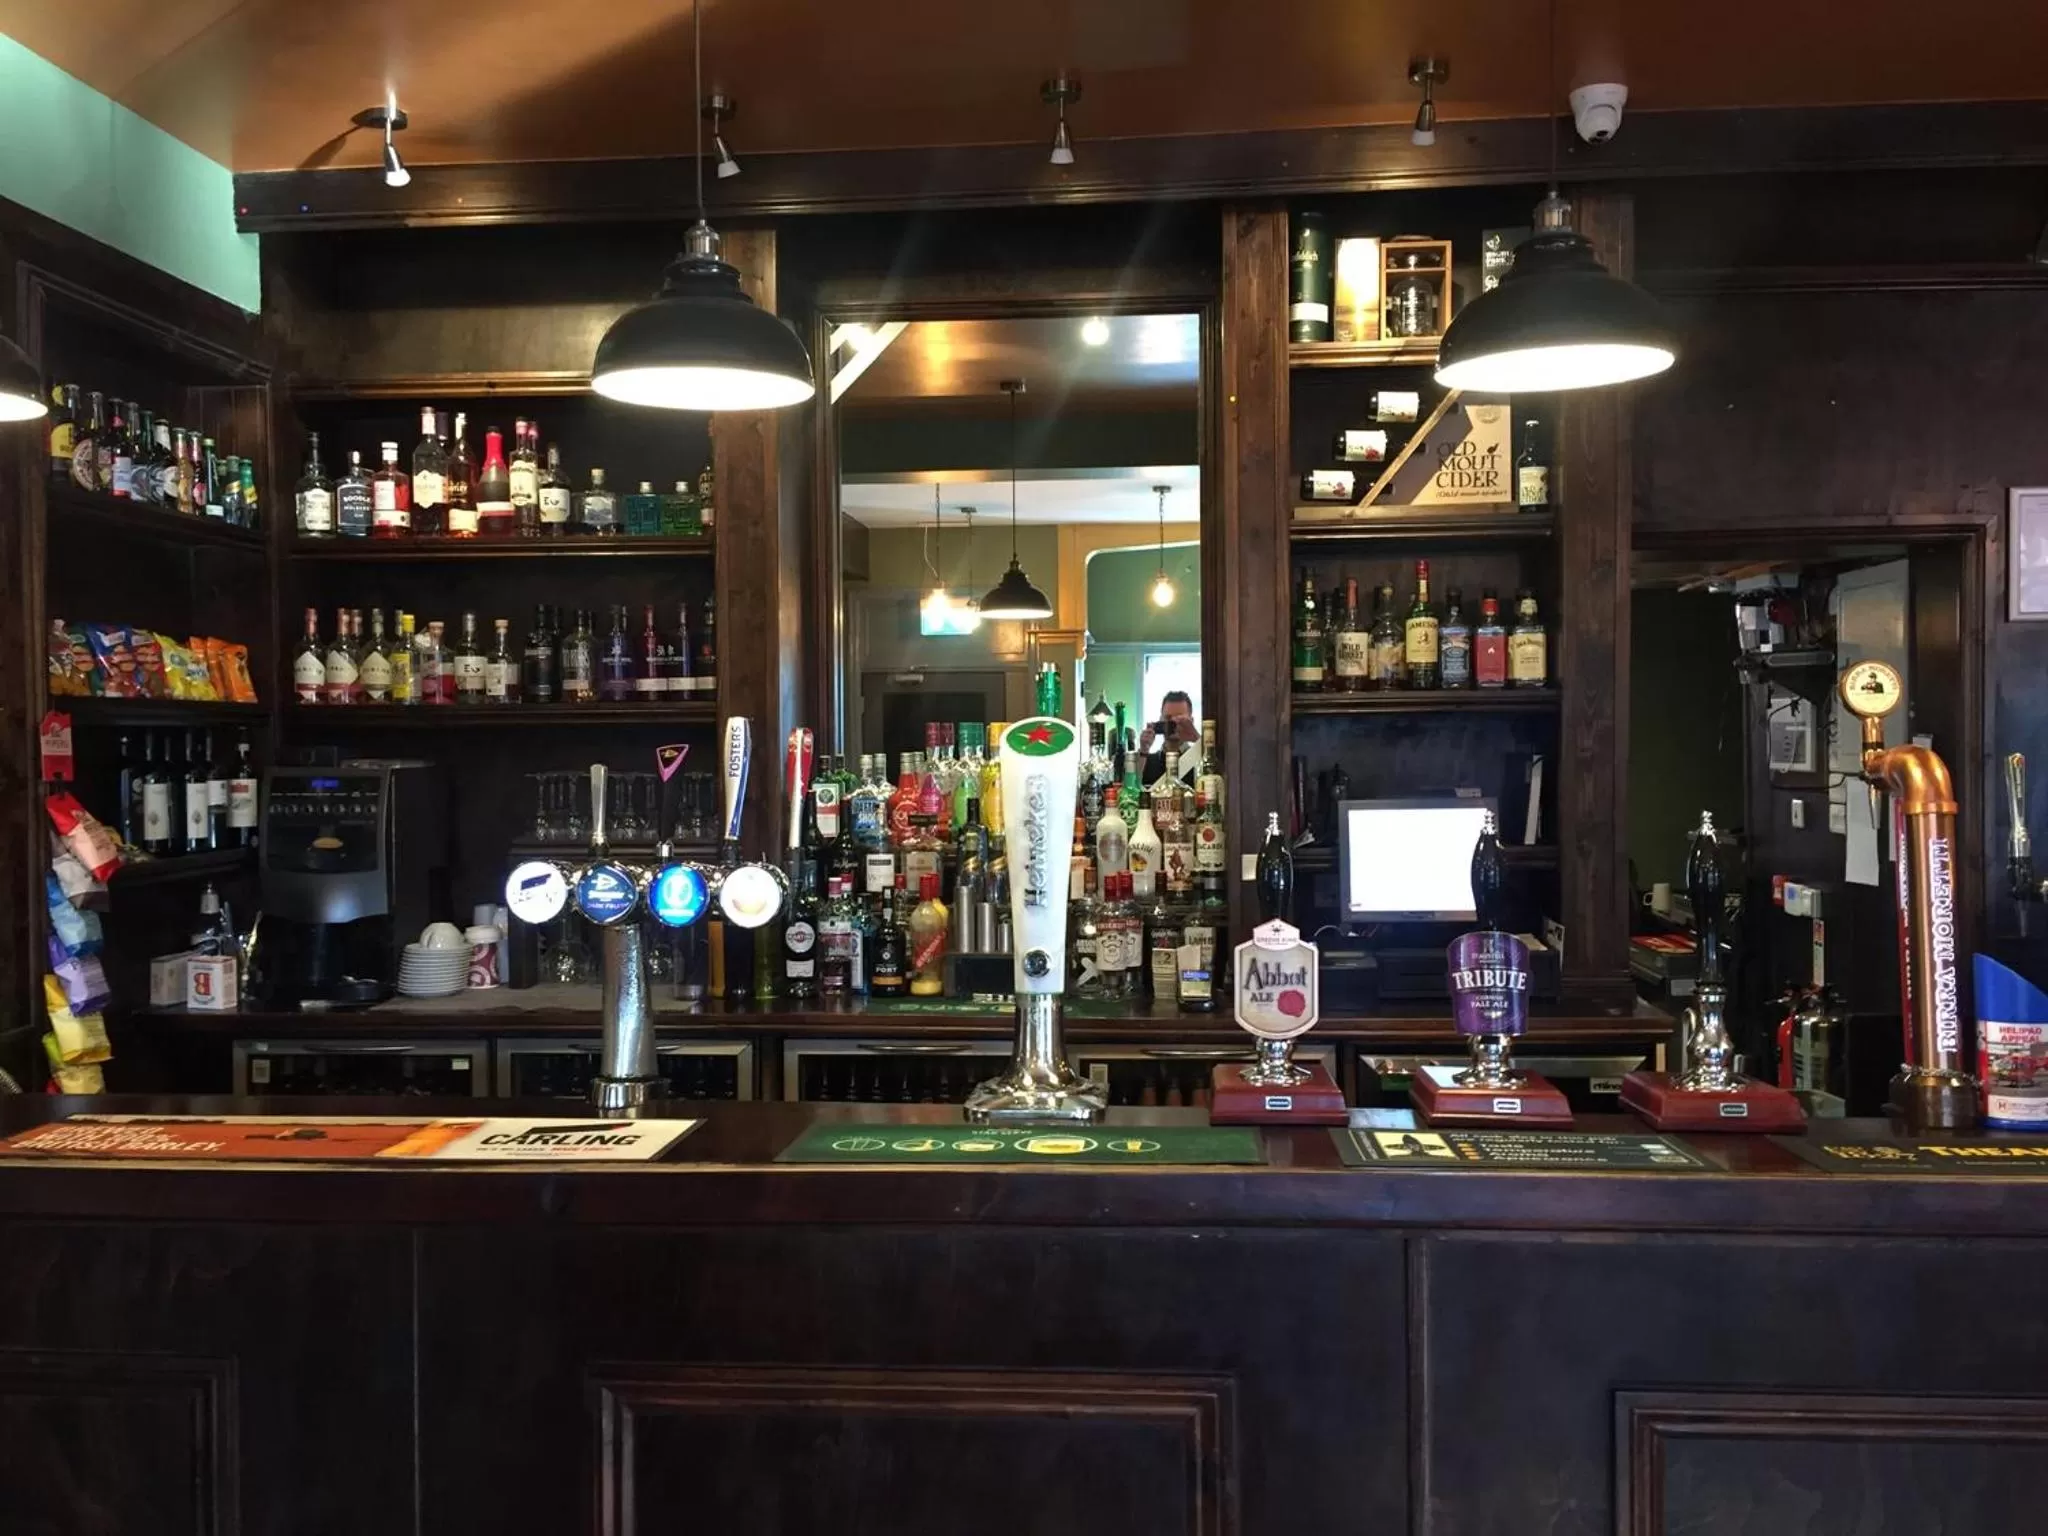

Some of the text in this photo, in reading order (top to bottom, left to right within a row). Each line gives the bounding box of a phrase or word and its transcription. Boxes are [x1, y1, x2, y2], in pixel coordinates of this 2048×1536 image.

[1437, 441, 1477, 456] OLD
[1439, 454, 1502, 471] MOUT
[1436, 470, 1499, 488] CIDER
[729, 725, 742, 778] FOSTERS
[1023, 774, 1048, 910] Heineken
[1928, 837, 1958, 1054] BIRRA MORETTI
[877, 966, 898, 974] PORT
[1244, 956, 1309, 991] Abbot
[1452, 969, 1528, 990] TRIBUTE
[1250, 992, 1274, 1003] ALE
[1999, 1026, 2042, 1035] HELIPAD
[2001, 1035, 2040, 1043] APPEAL
[479, 1133, 643, 1146] CARLING
